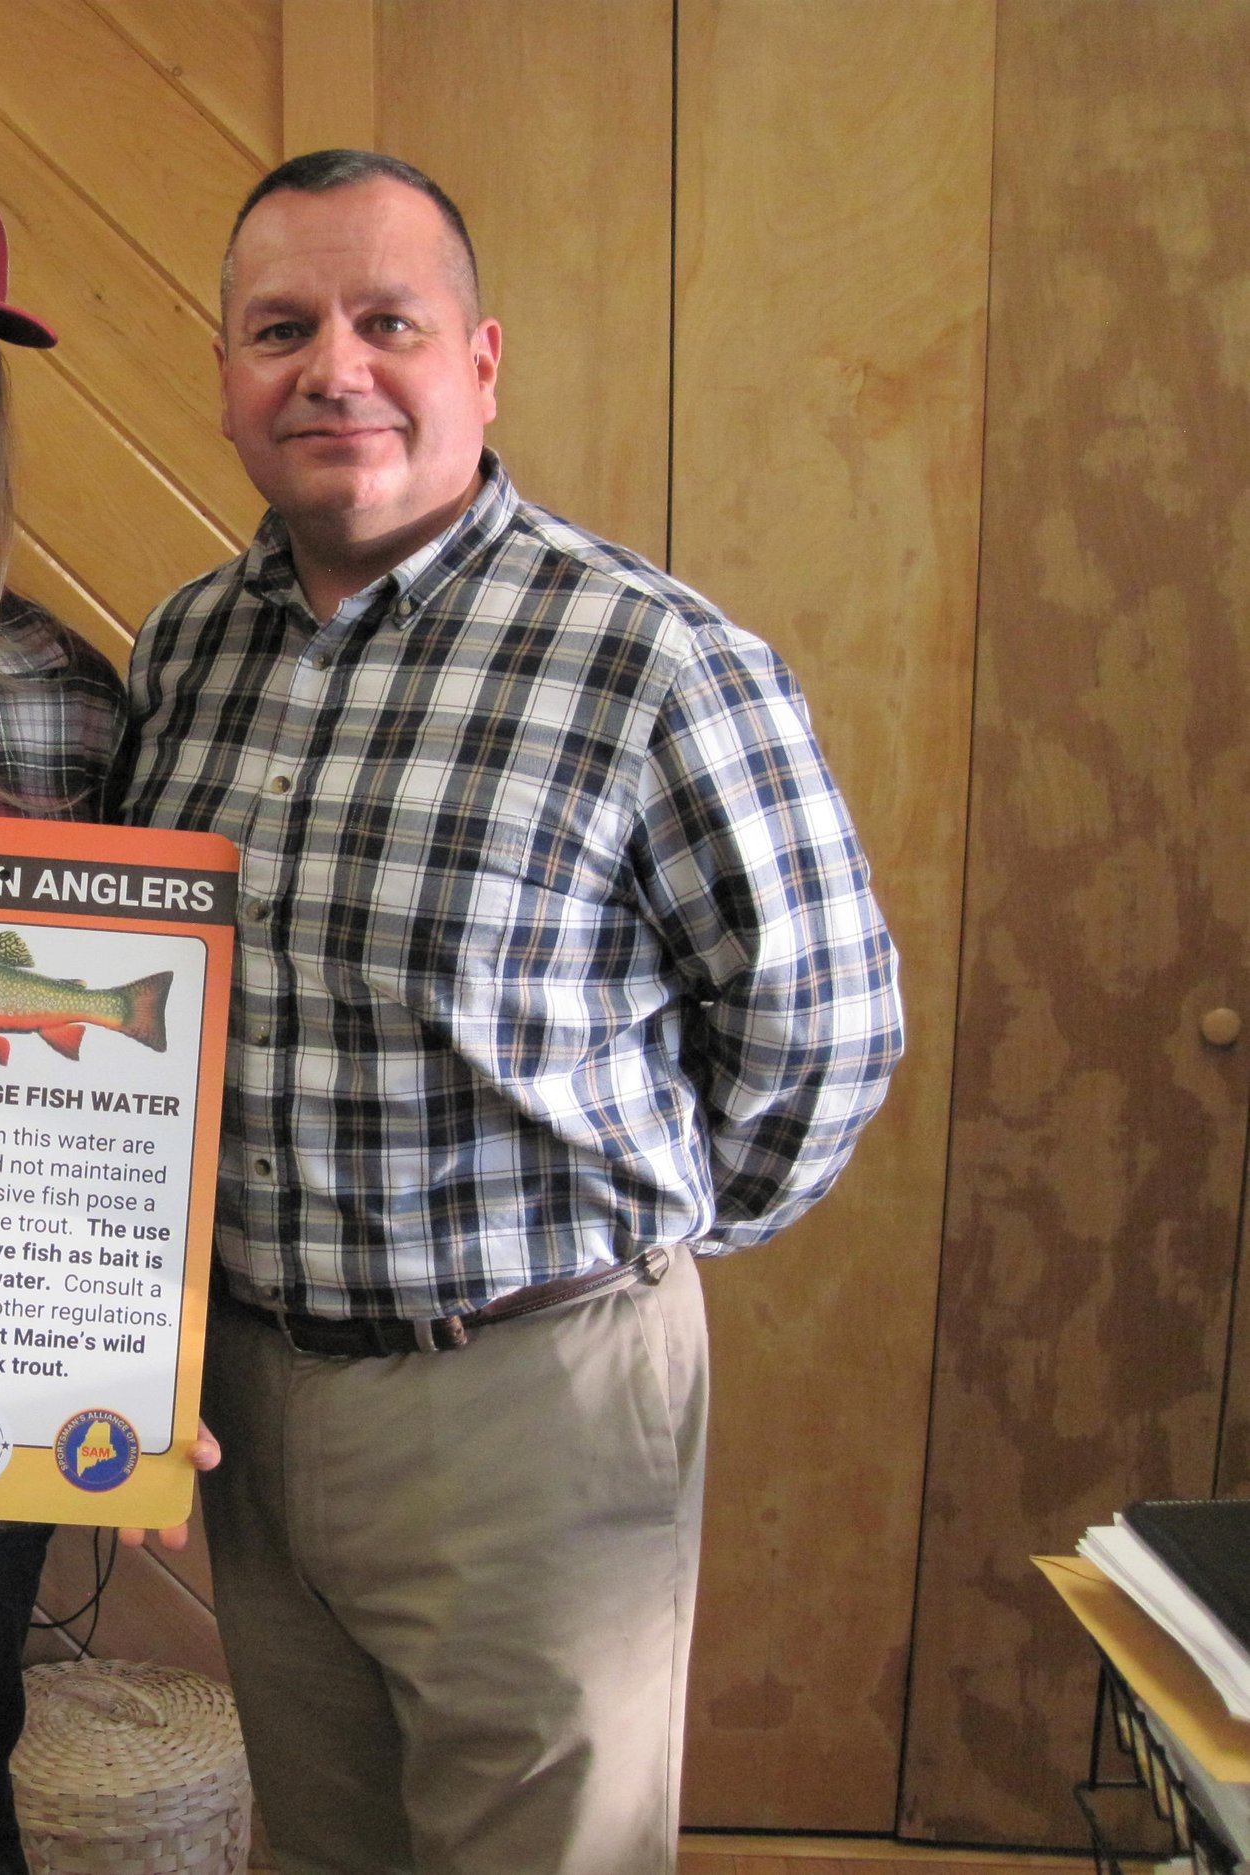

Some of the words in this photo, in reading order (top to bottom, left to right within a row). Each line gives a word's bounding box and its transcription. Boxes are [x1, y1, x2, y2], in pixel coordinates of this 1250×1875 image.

[31, 869, 215, 912] ANGLERS
[26, 1086, 84, 1110] FISH
[91, 1090, 180, 1117] WATER
[13, 1127, 51, 1148] this
[58, 1134, 116, 1152] water
[122, 1139, 155, 1155] are
[10, 1159, 44, 1176] not
[50, 1160, 167, 1184] maintained
[42, 1185, 79, 1207] fish
[86, 1194, 137, 1213] pose
[144, 1198, 155, 1212] a
[18, 1215, 72, 1235] trout.
[87, 1218, 127, 1239] The
[133, 1225, 170, 1241] use
[22, 1241, 62, 1263] fish
[68, 1250, 92, 1265] as
[99, 1246, 139, 1268] bait
[145, 1250, 163, 1270] is
[64, 1274, 144, 1297] Consult
[150, 1284, 161, 1298] a
[51, 1304, 172, 1327] regulations.
[14, 1327, 96, 1351] Maine's
[103, 1334, 145, 1354] wild
[11, 1357, 68, 1377] trout.
[88, 1411, 129, 1432] ALLIANCE
[57, 1414, 86, 1472] SPORTSMAN'S
[126, 1432, 136, 1443] OF
[81, 1446, 110, 1458] SAM
[123, 1446, 137, 1474] MAINE
